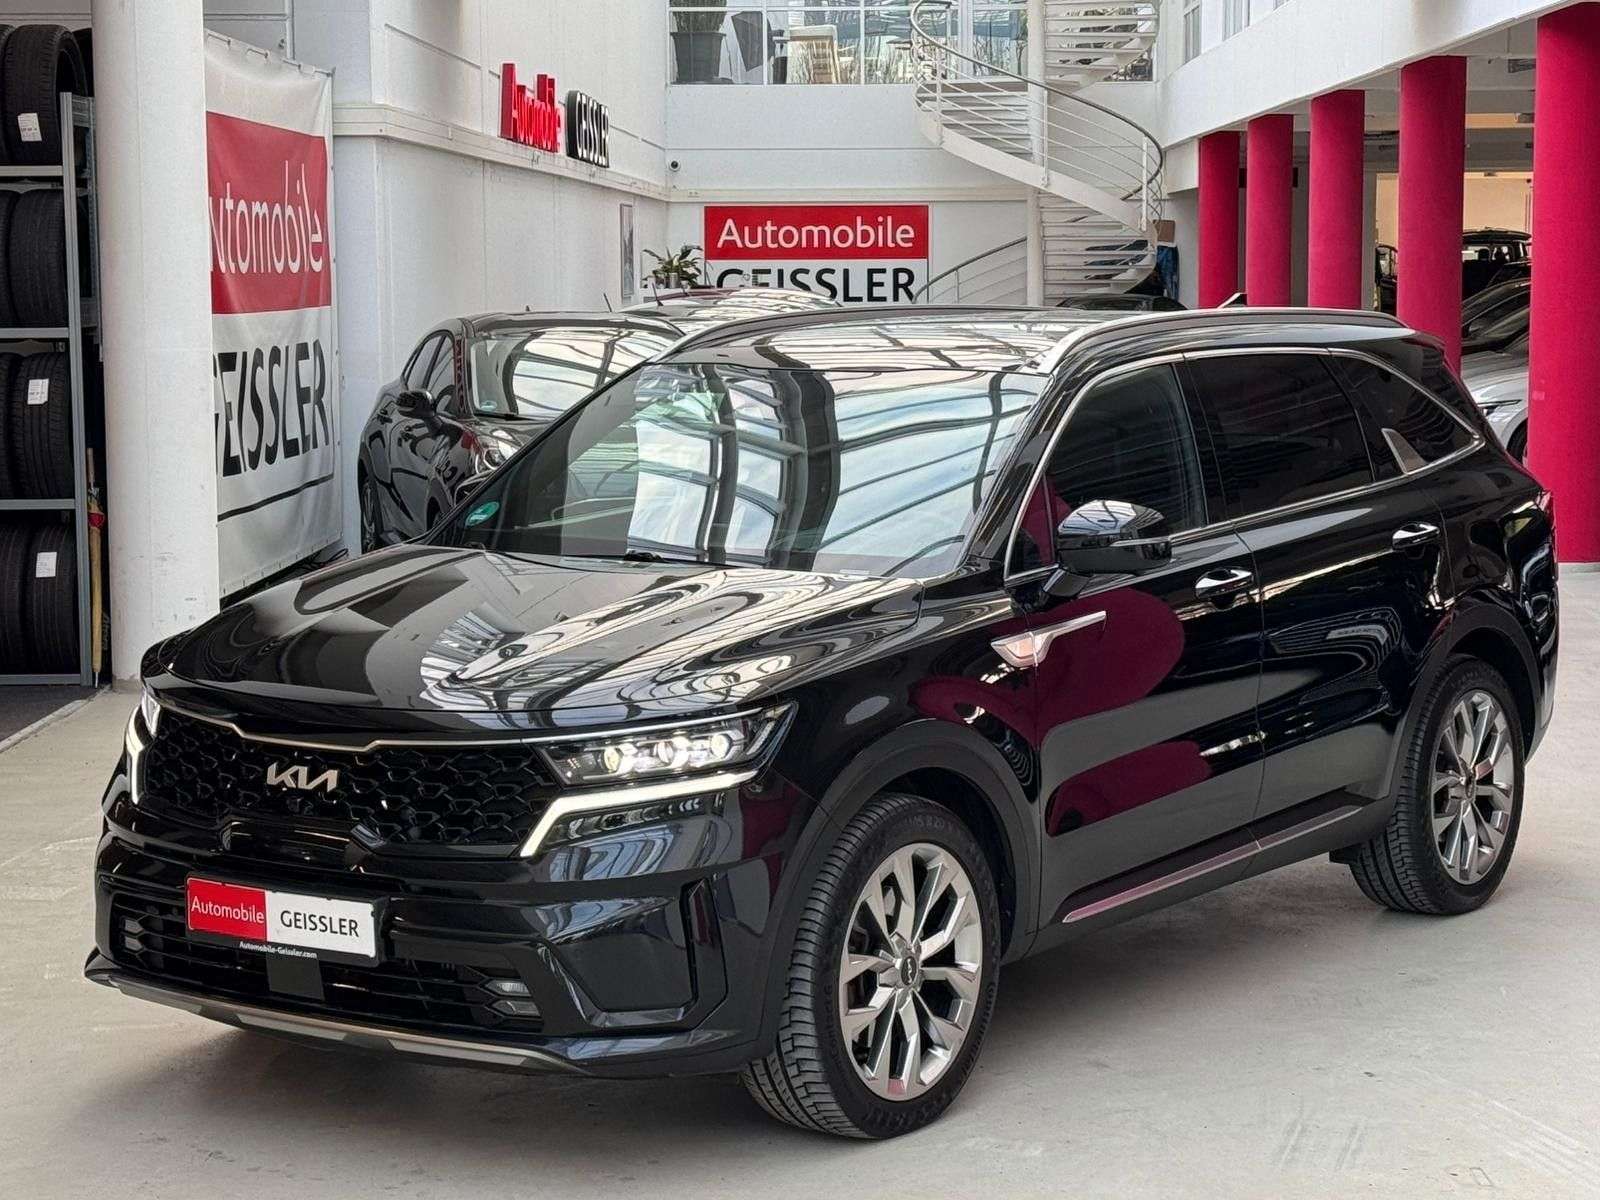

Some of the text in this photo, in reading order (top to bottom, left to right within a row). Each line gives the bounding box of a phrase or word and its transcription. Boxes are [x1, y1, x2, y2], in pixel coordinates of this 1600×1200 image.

[209, 160, 323, 274] utomobile
[717, 216, 915, 249] Automobile
[266, 761, 339, 793] KIA
[191, 896, 360, 937] Automobile GEISSLER
[239, 941, 318, 959] Automobile-Geissler.com
